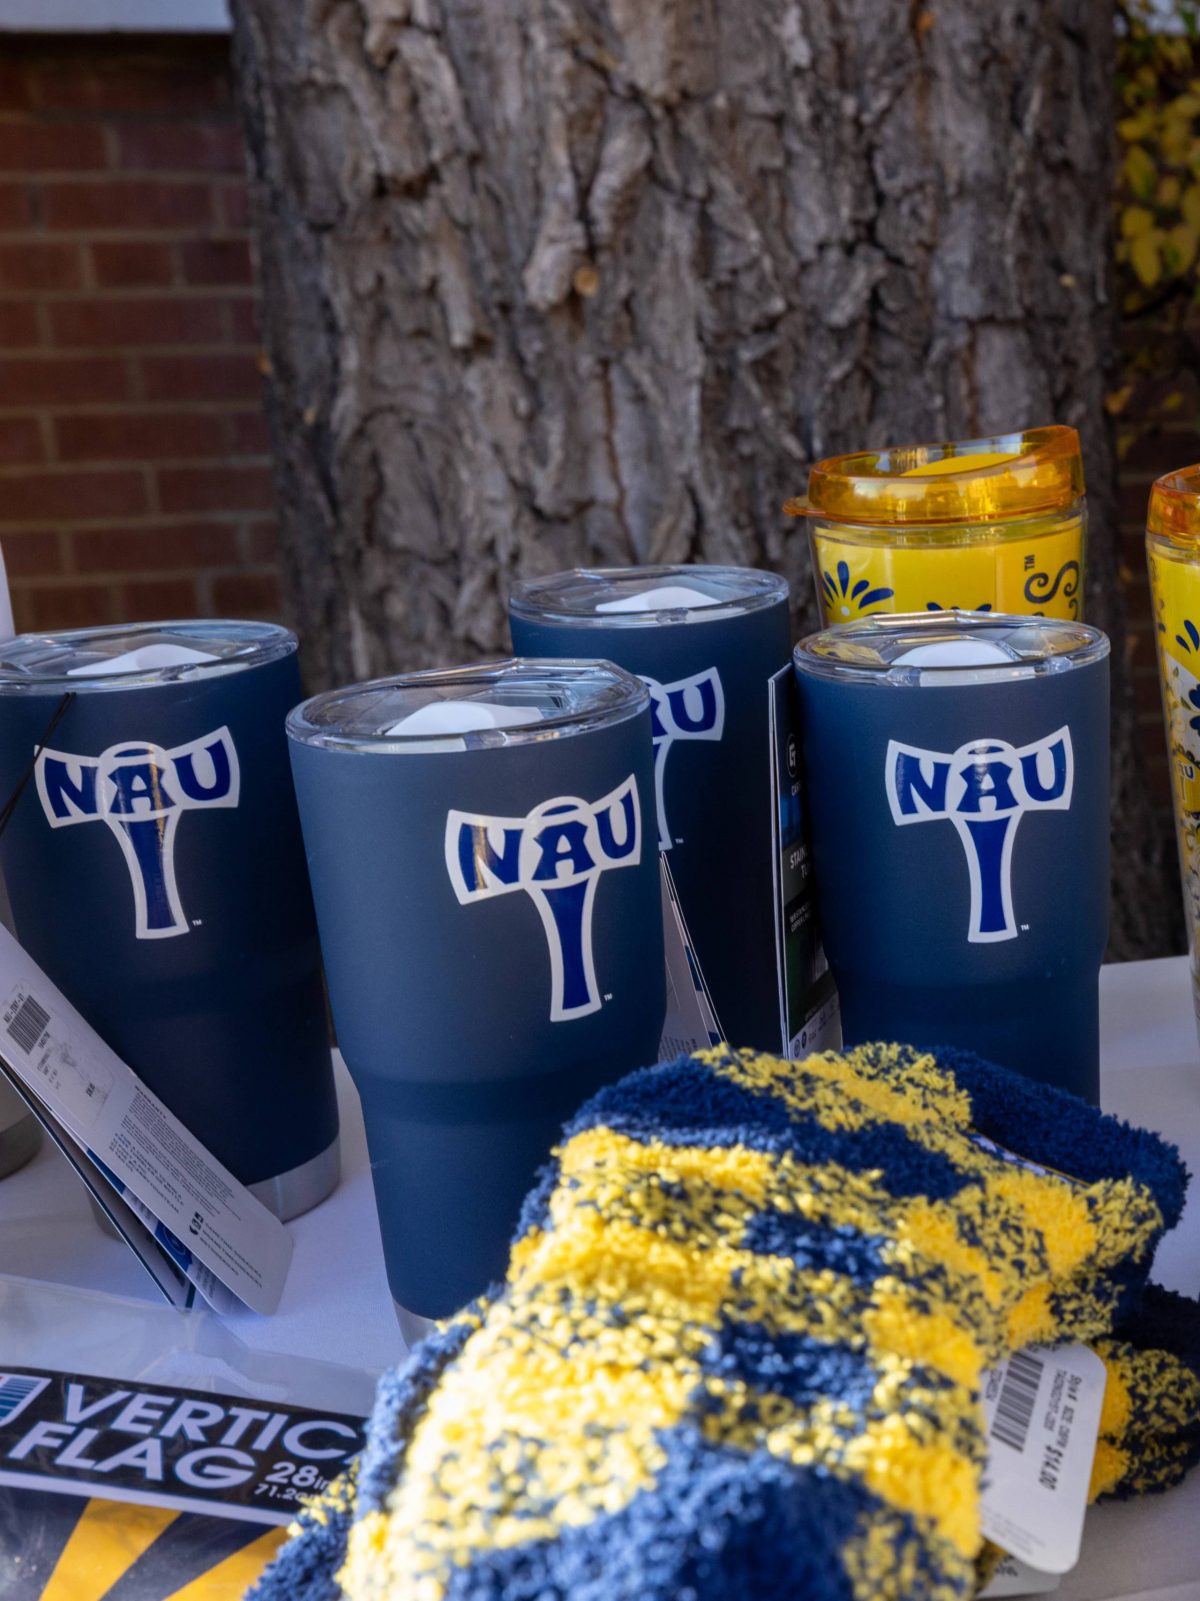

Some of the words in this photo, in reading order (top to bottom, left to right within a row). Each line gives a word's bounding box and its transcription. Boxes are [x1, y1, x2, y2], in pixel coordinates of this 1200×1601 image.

[44, 739, 231, 818] NAU
[895, 738, 1066, 815] NAU
[458, 789, 636, 893] NAU
[9, 1420, 257, 1489] FLAG
[65, 1383, 361, 1464] VERTIC
